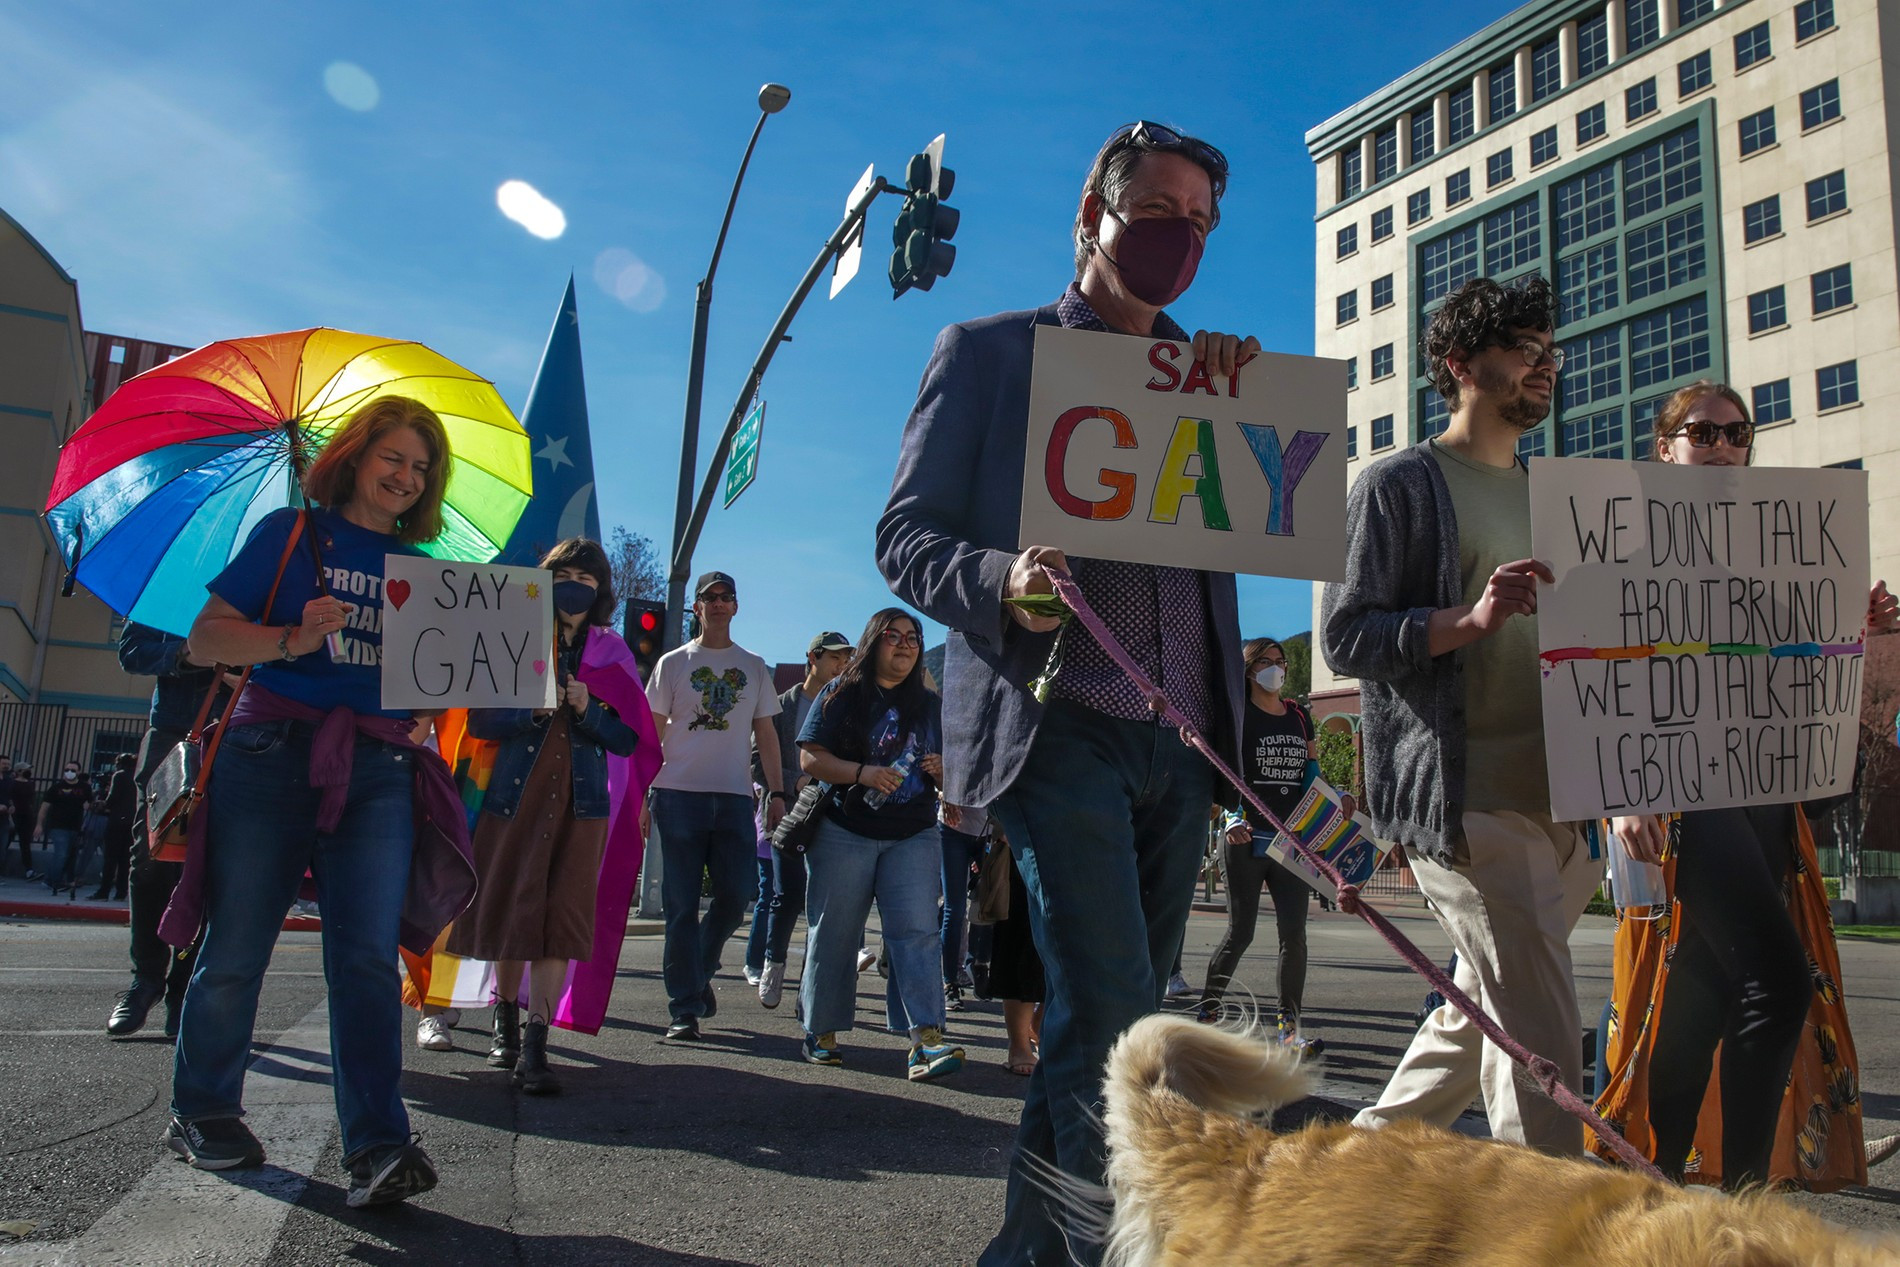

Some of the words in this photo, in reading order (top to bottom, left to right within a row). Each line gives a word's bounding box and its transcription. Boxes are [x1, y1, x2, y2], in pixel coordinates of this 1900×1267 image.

[1146, 341, 1257, 398] SAY
[1045, 406, 1330, 536] GAY
[1569, 496, 1632, 563] WE
[1648, 498, 1736, 567] DON'T
[1752, 499, 1847, 568] TALK
[434, 569, 509, 610] SAY
[1619, 578, 1720, 649] ABOUT
[412, 627, 529, 696] GAY
[1571, 659, 1634, 717] WE
[1649, 653, 1700, 724] DO
[1705, 652, 1788, 720] TALK
[1788, 654, 1863, 717] ABOUT
[1256, 747, 1266, 757] IS
[1267, 747, 1281, 756] MY
[1256, 757, 1283, 767] THEIR
[1259, 735, 1286, 746] YOUR
[1286, 735, 1307, 748] FIGH
[1261, 767, 1281, 779] OUR
[1725, 723, 1840, 800] RIGHTS!
